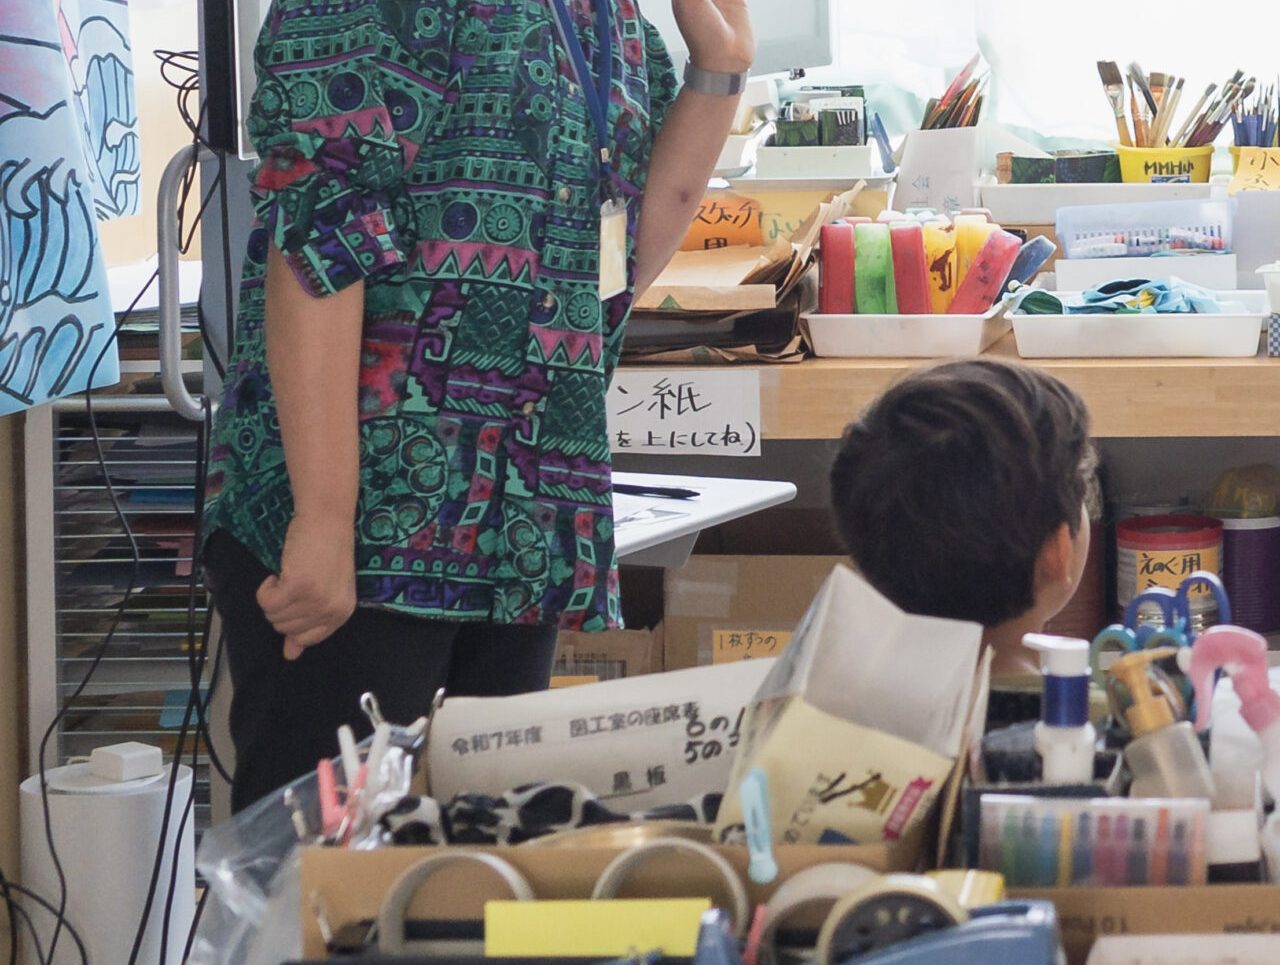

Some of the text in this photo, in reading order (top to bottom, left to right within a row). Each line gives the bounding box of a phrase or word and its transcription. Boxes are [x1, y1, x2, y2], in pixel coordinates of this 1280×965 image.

[1241, 150, 1280, 191] 小ふ
[692, 201, 758, 229] スケッチ
[616, 377, 713, 420] ン紙
[451, 725, 543, 756] 令和7年度
